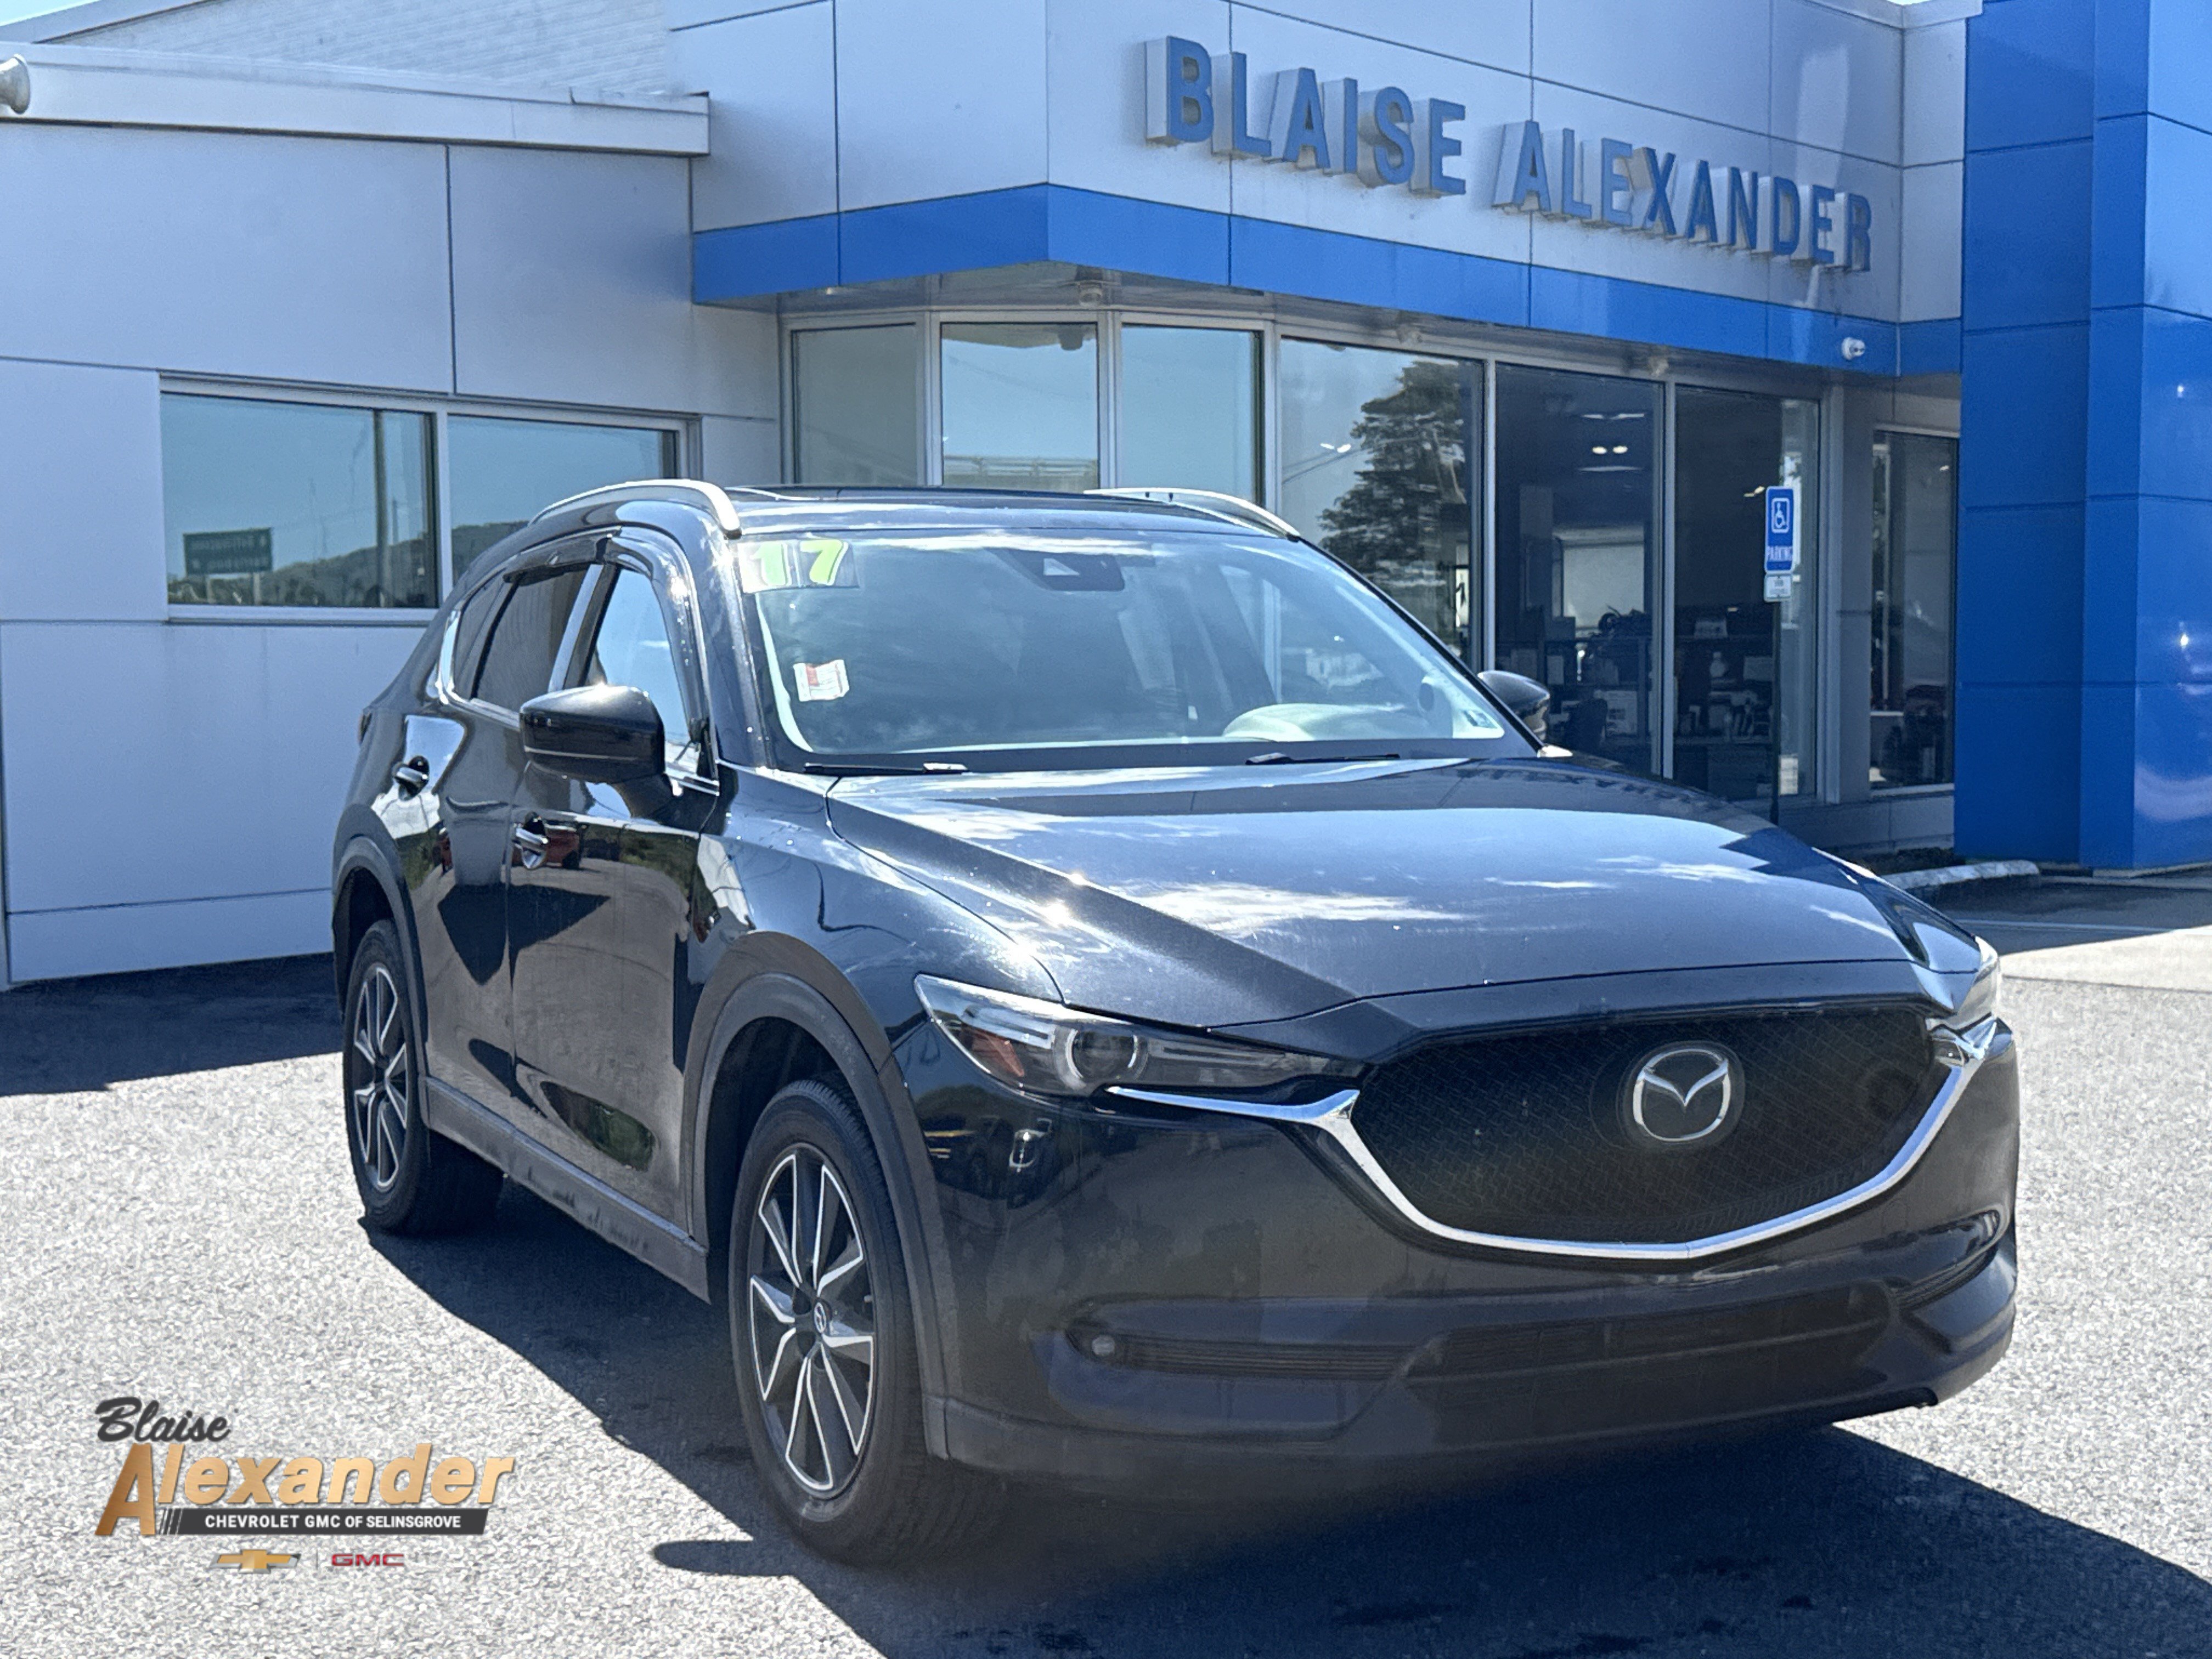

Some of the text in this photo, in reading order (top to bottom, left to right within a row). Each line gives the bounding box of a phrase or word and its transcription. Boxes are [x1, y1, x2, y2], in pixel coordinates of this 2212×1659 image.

[1165, 35, 1872, 272] BLAISE ALEXANDER
[750, 539, 849, 586] 17
